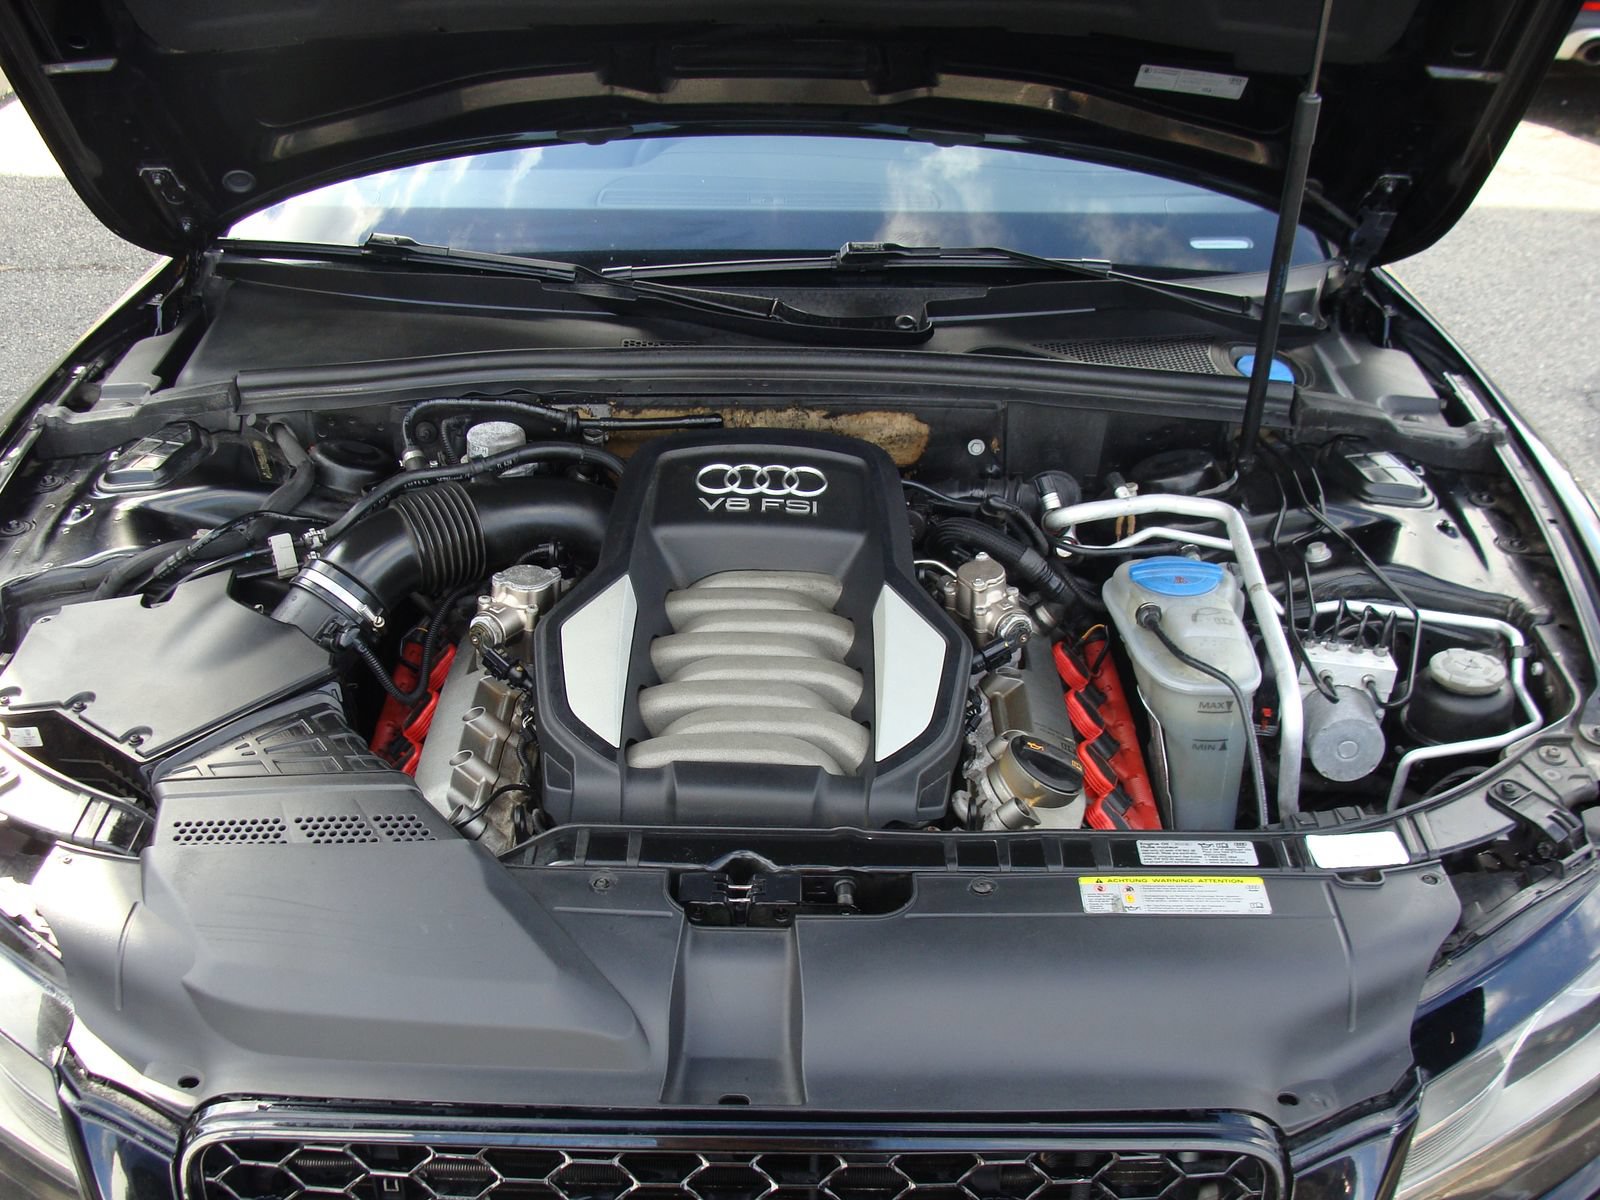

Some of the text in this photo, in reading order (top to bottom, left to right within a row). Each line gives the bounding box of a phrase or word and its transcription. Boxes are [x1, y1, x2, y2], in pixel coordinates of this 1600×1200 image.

[698, 497, 818, 516] V8 FSI
[1199, 701, 1225, 710] MAX
[1191, 743, 1216, 751] MIN
